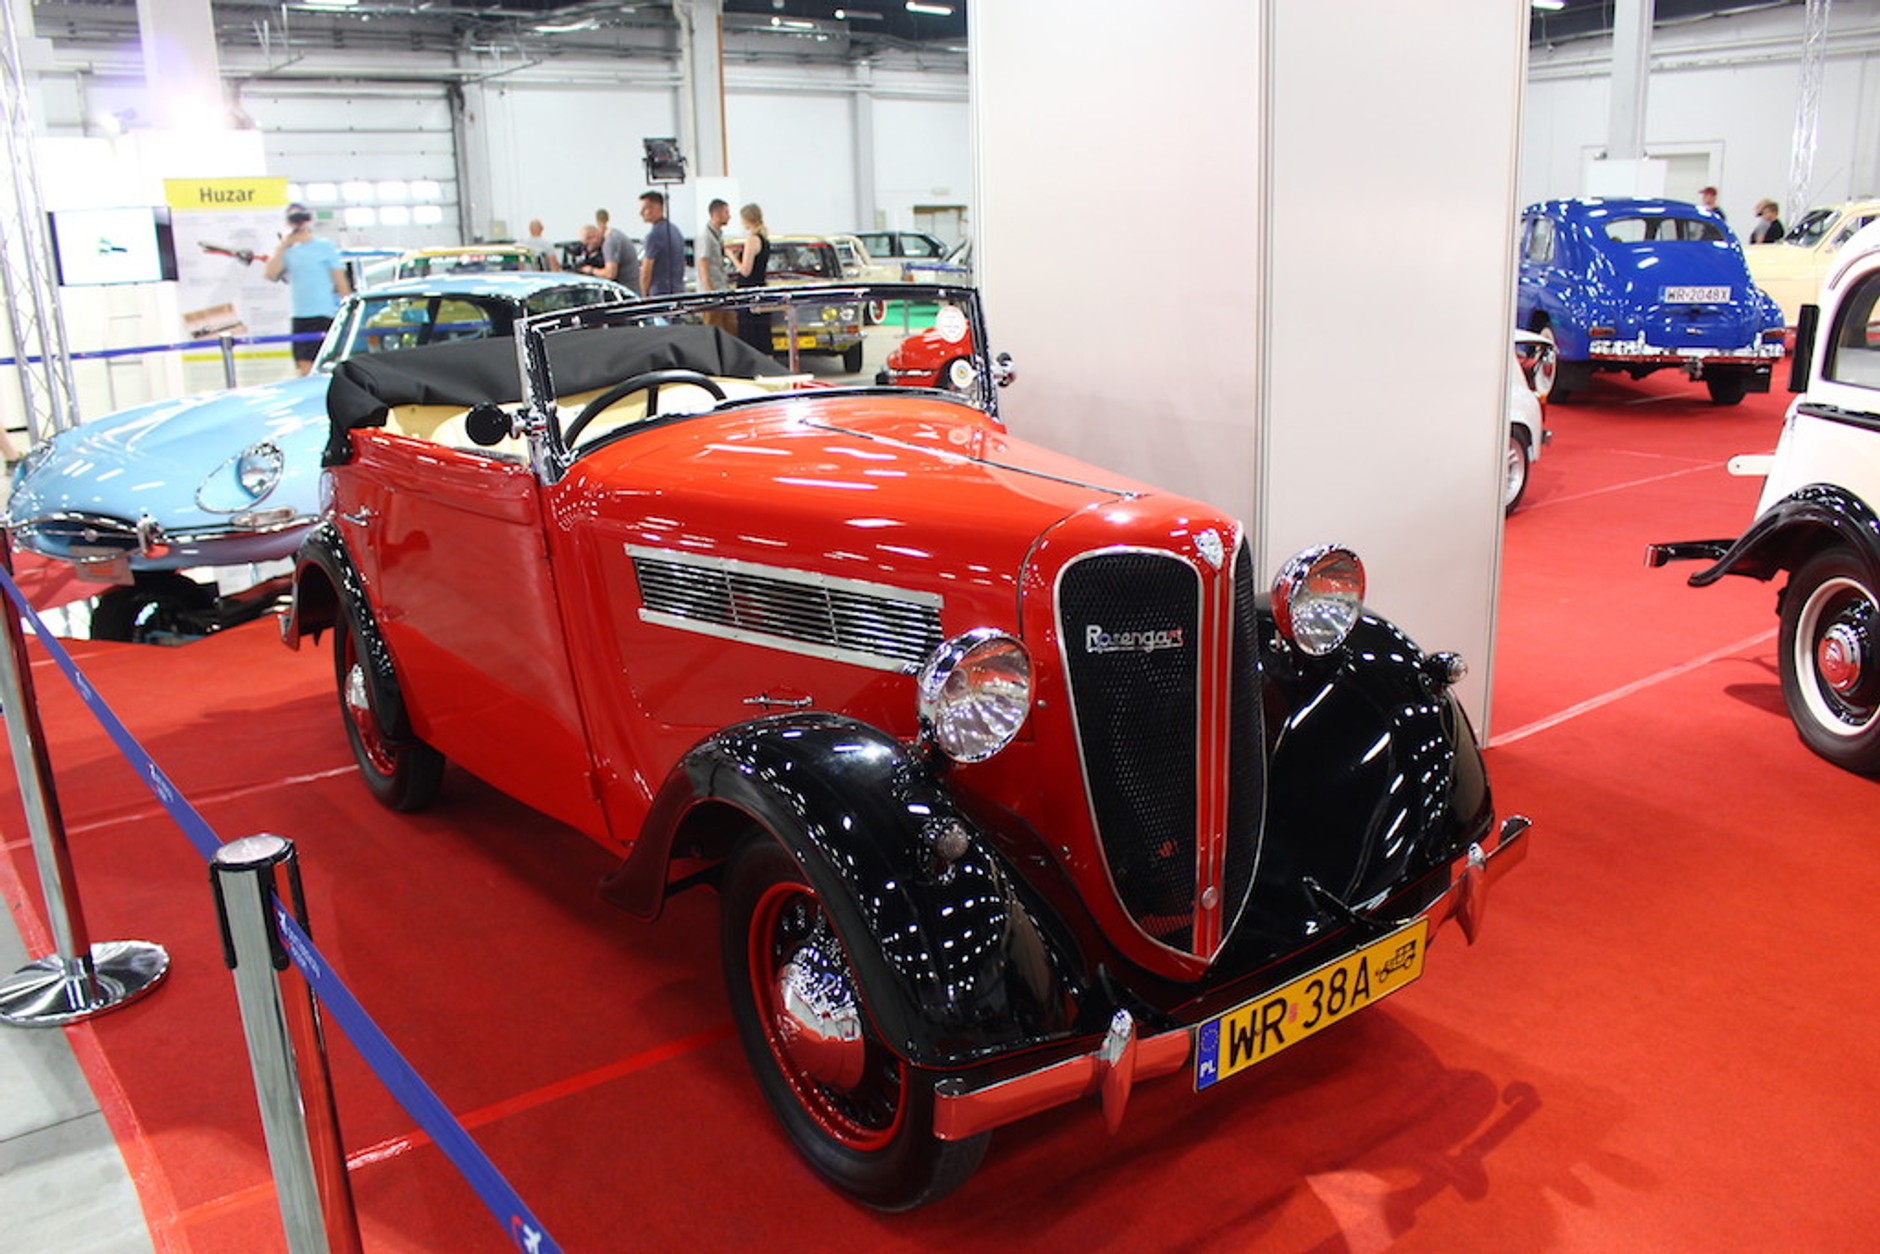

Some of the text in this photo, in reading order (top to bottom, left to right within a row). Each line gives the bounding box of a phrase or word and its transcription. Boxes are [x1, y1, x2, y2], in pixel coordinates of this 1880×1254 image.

[199, 187, 255, 203] Huzar
[1086, 624, 1184, 654] Rosengart
[1229, 956, 1371, 1069] WR 38A
[1199, 1060, 1217, 1078] PL
